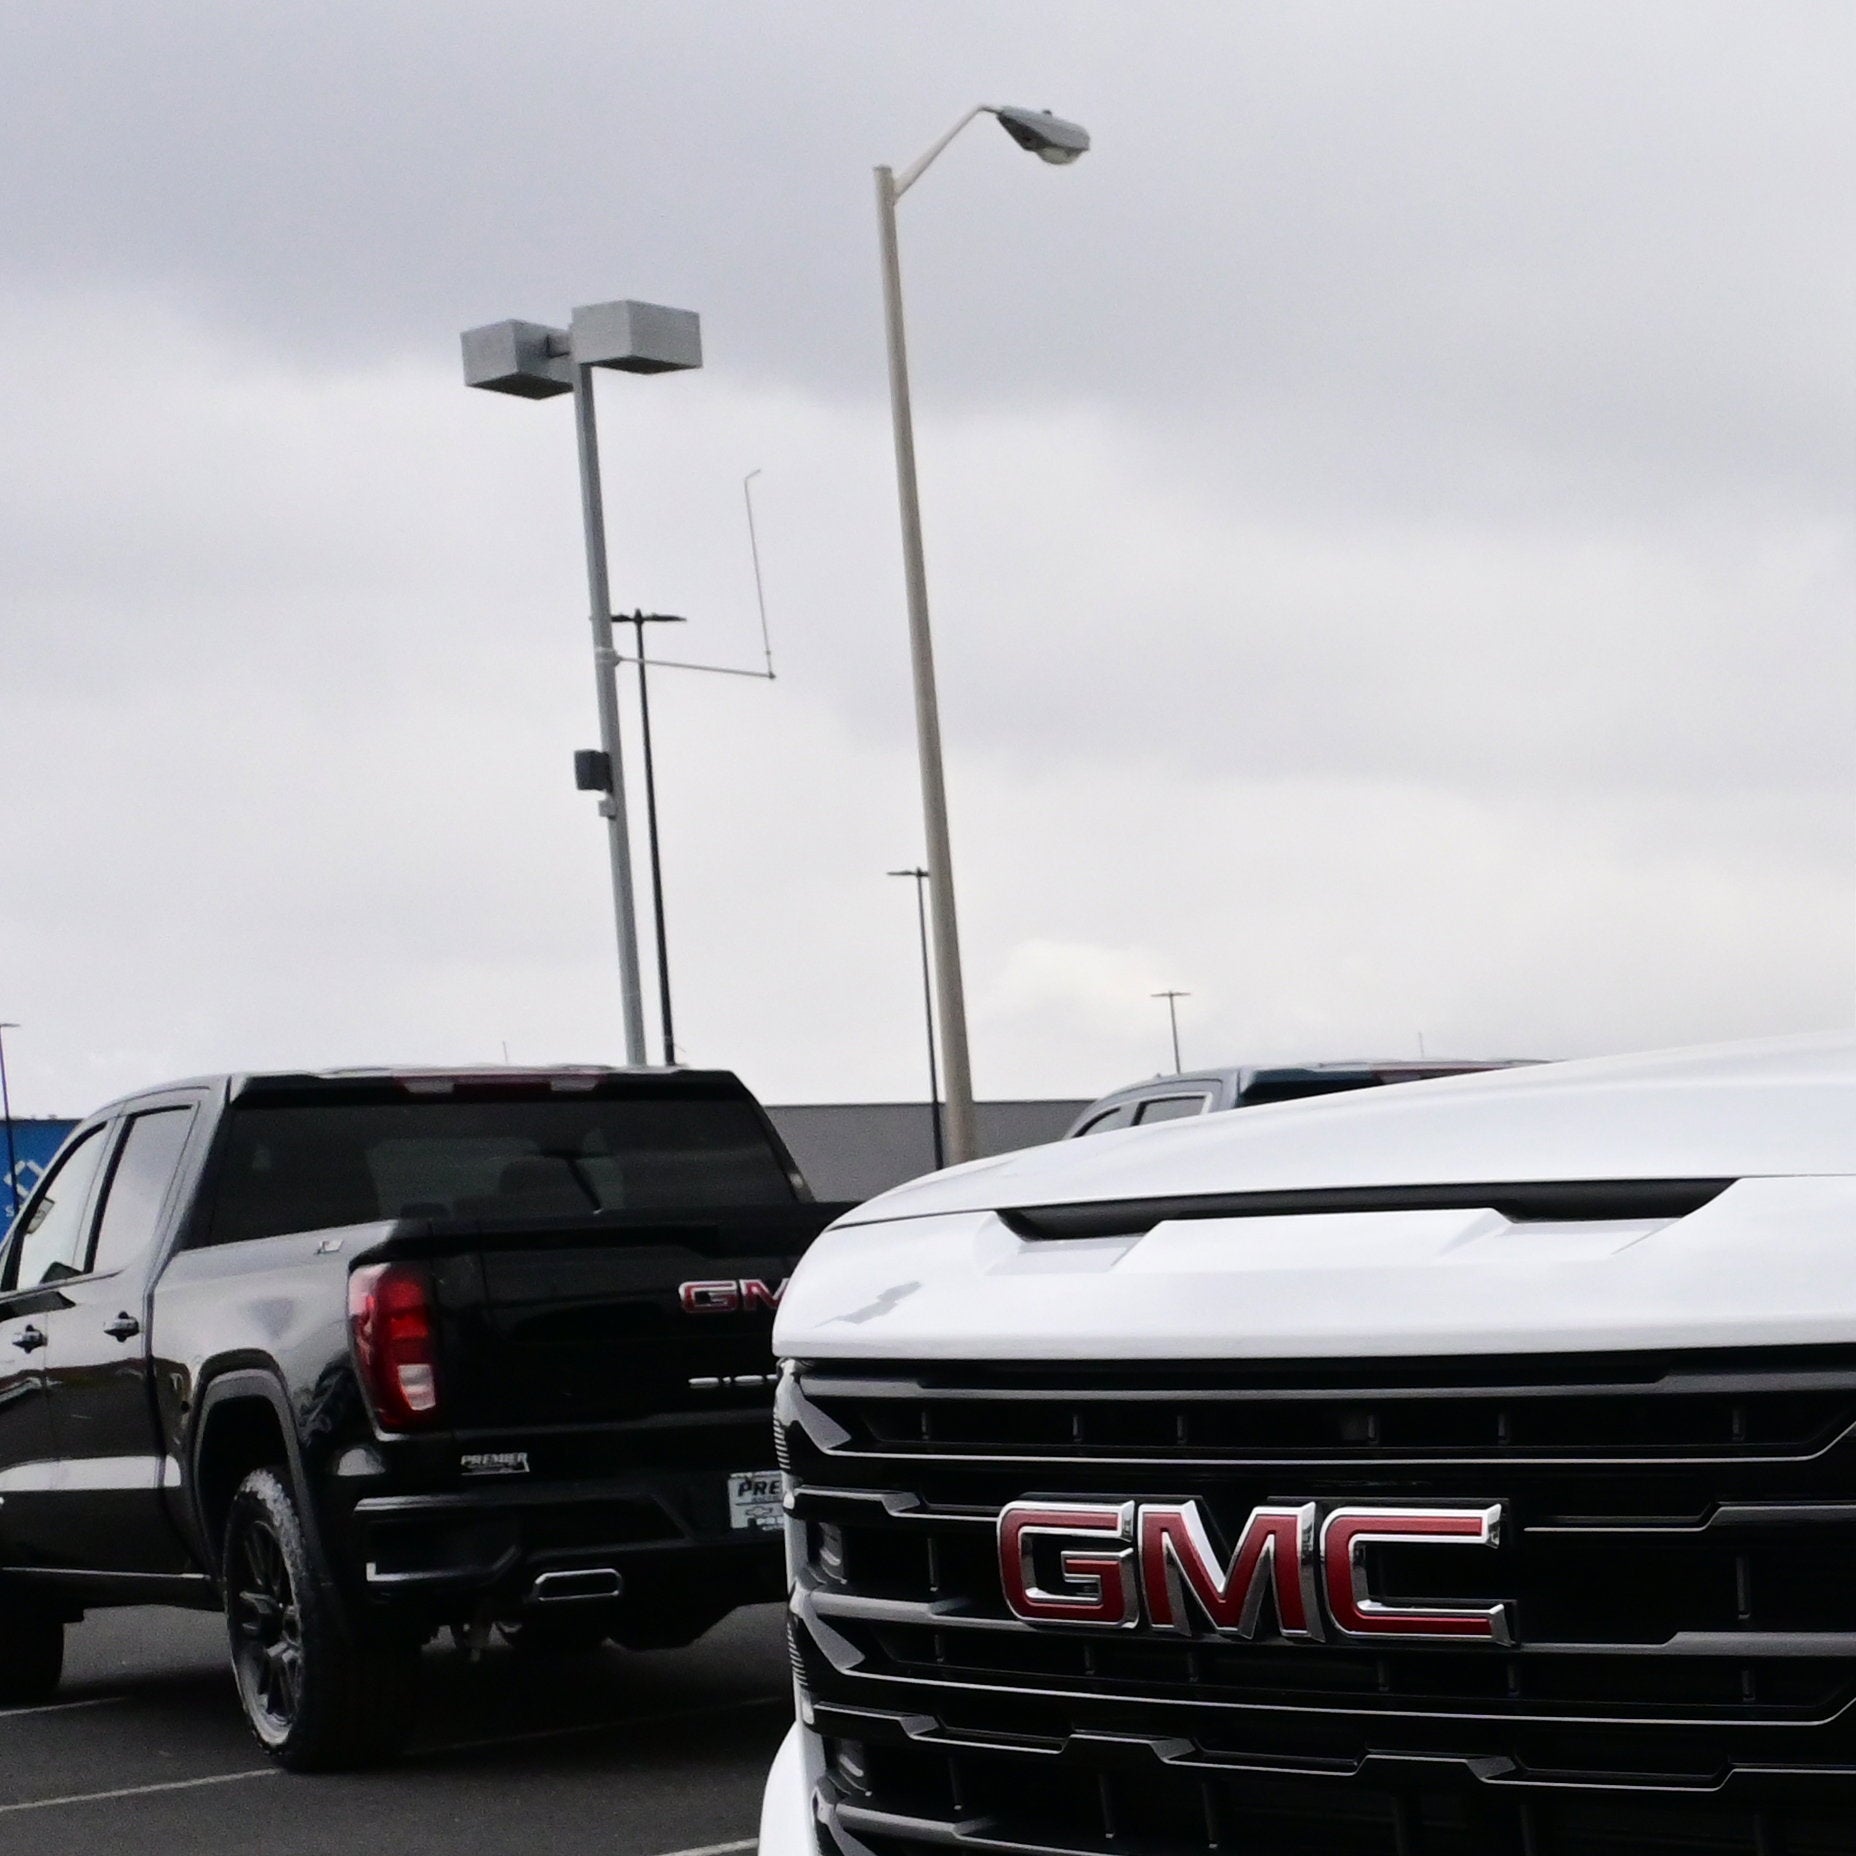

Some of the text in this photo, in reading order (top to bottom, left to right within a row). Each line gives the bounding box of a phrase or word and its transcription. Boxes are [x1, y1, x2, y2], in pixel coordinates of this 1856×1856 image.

[678, 1277, 791, 1313] GM
[737, 1480, 782, 1497] PRE
[997, 1499, 1518, 1646] GMC
